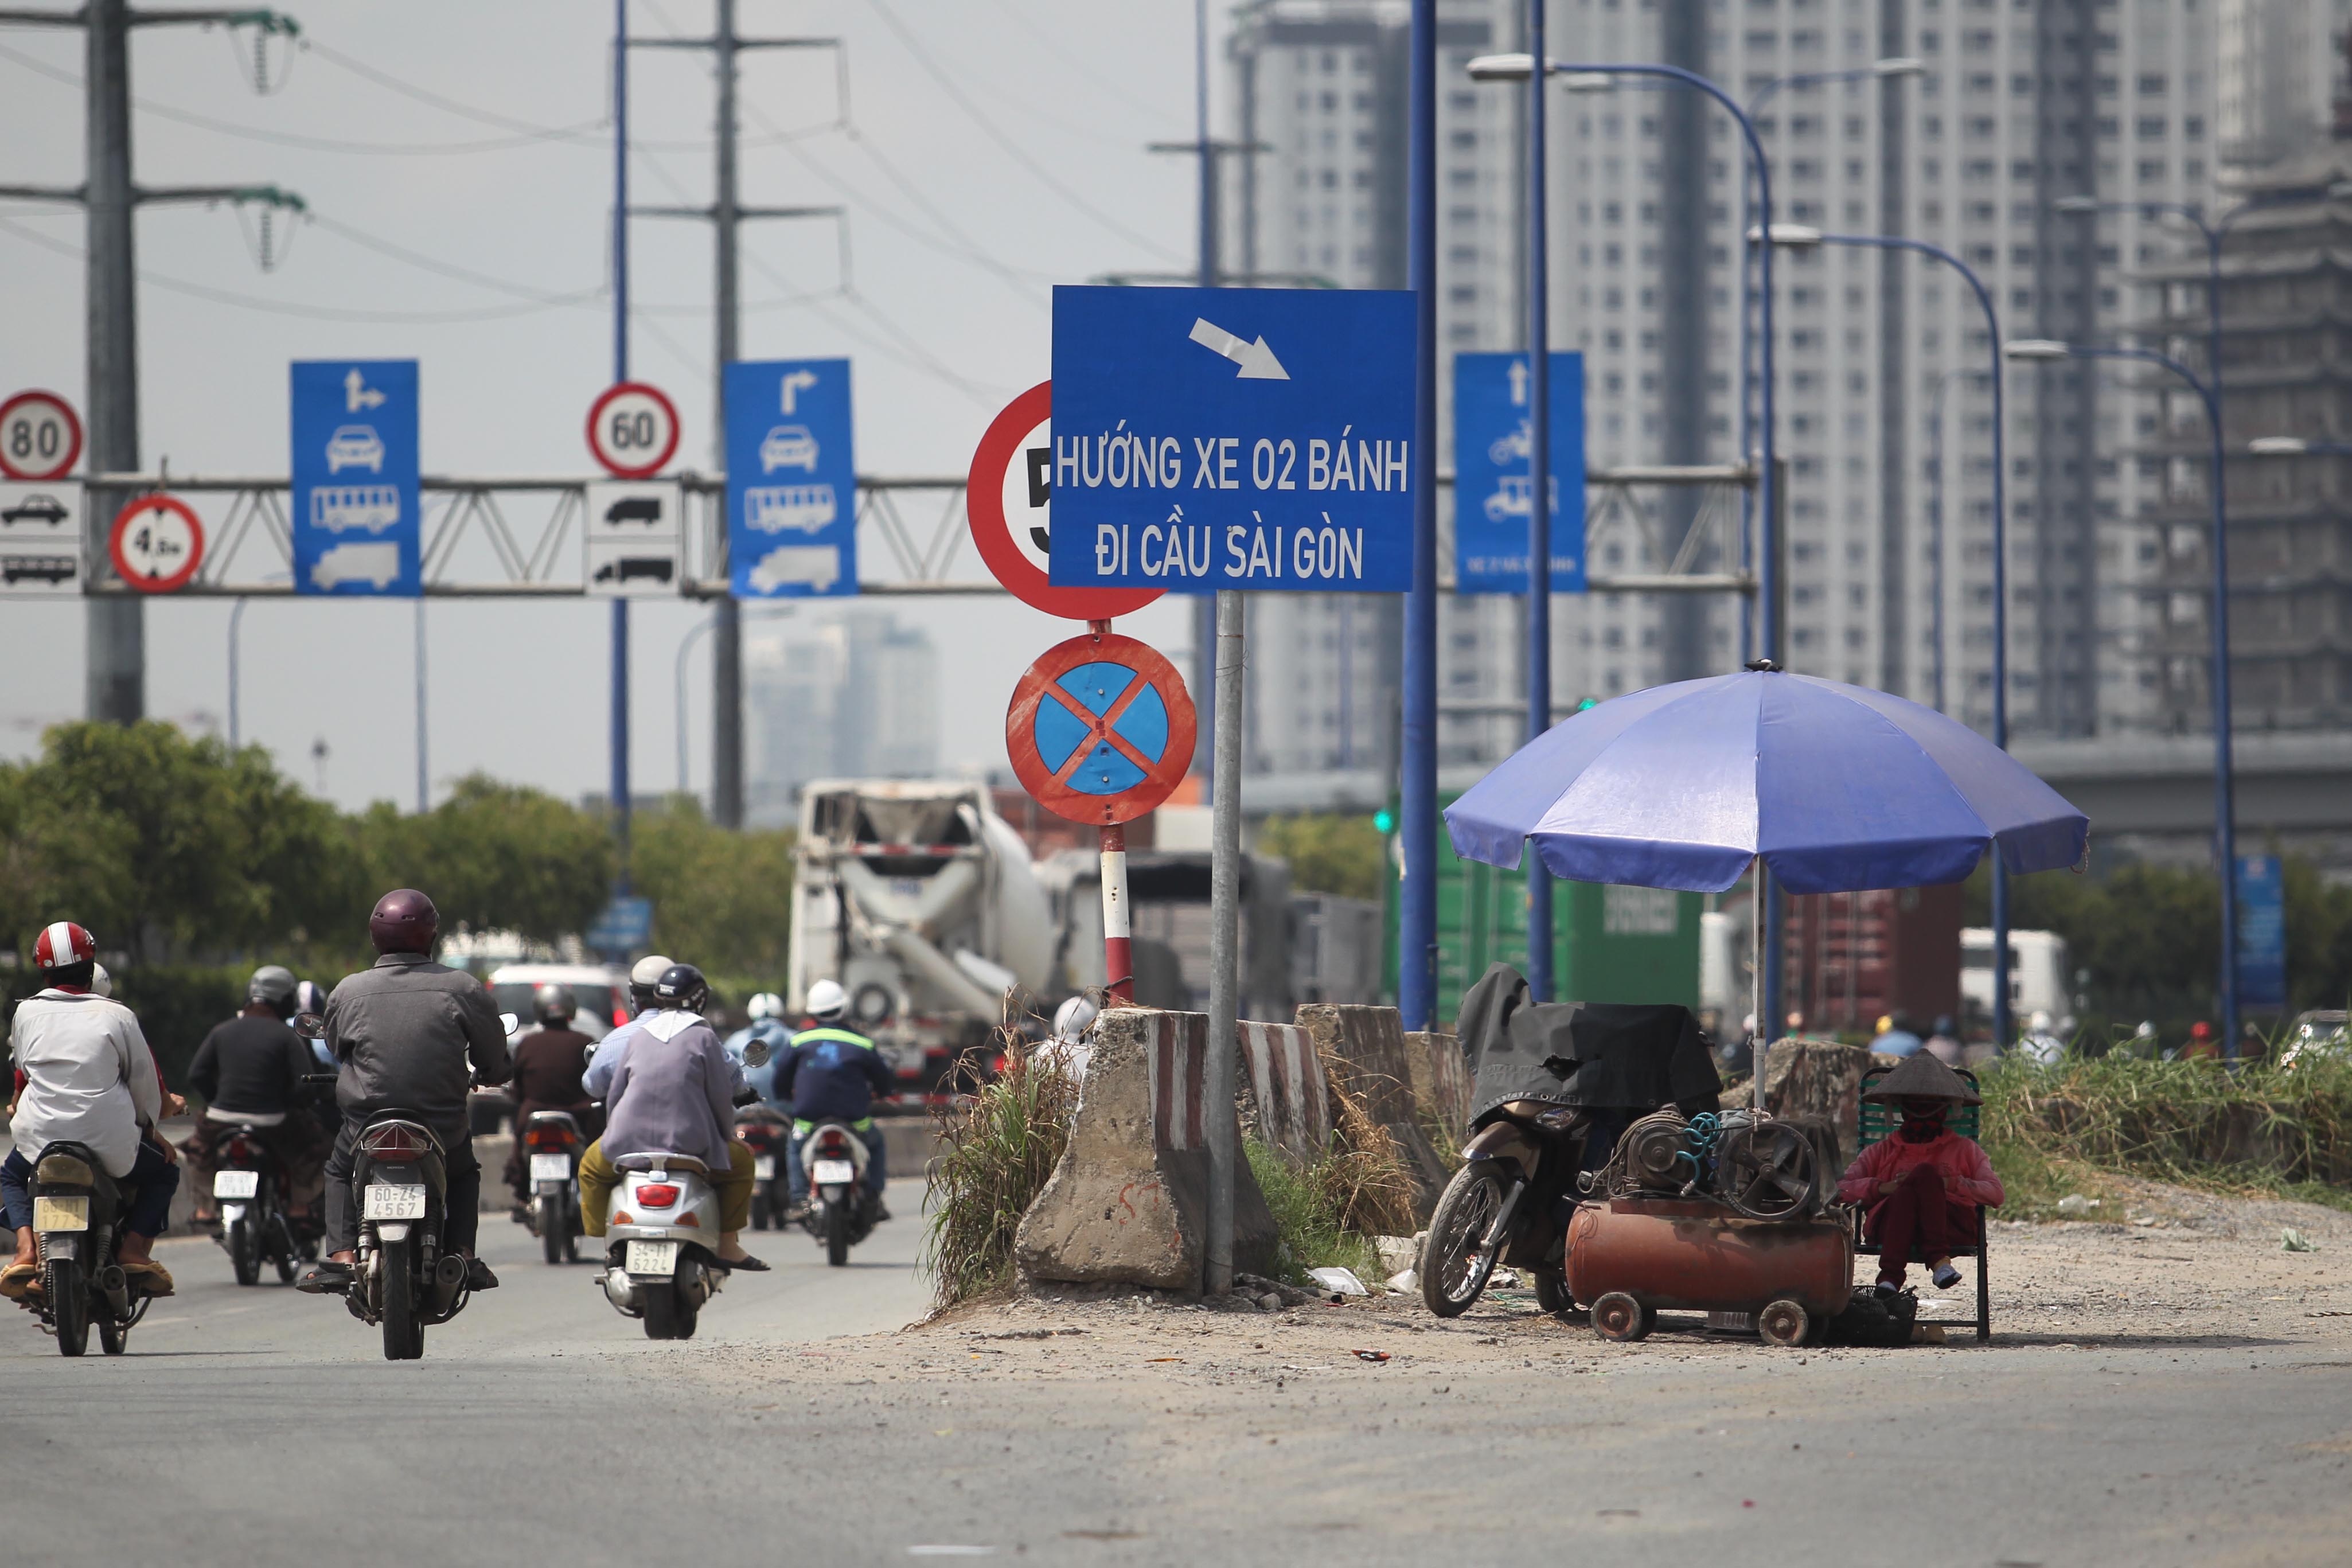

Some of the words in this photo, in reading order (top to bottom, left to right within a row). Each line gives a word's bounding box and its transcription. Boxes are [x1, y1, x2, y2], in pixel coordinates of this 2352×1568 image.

[11, 419, 59, 459] 80
[612, 413, 654, 449] 60
[1056, 419, 1181, 489] HƯỚNG
[1192, 437, 1239, 489] XE
[1253, 438, 1296, 490] 02
[1308, 424, 1407, 492] BÁNH
[1095, 524, 1129, 576] ĐI
[1141, 504, 1211, 577] CẦU
[1224, 510, 1282, 578] SÀI
[1293, 512, 1363, 579] GÒN
[374, 1202, 416, 1216] 4567
